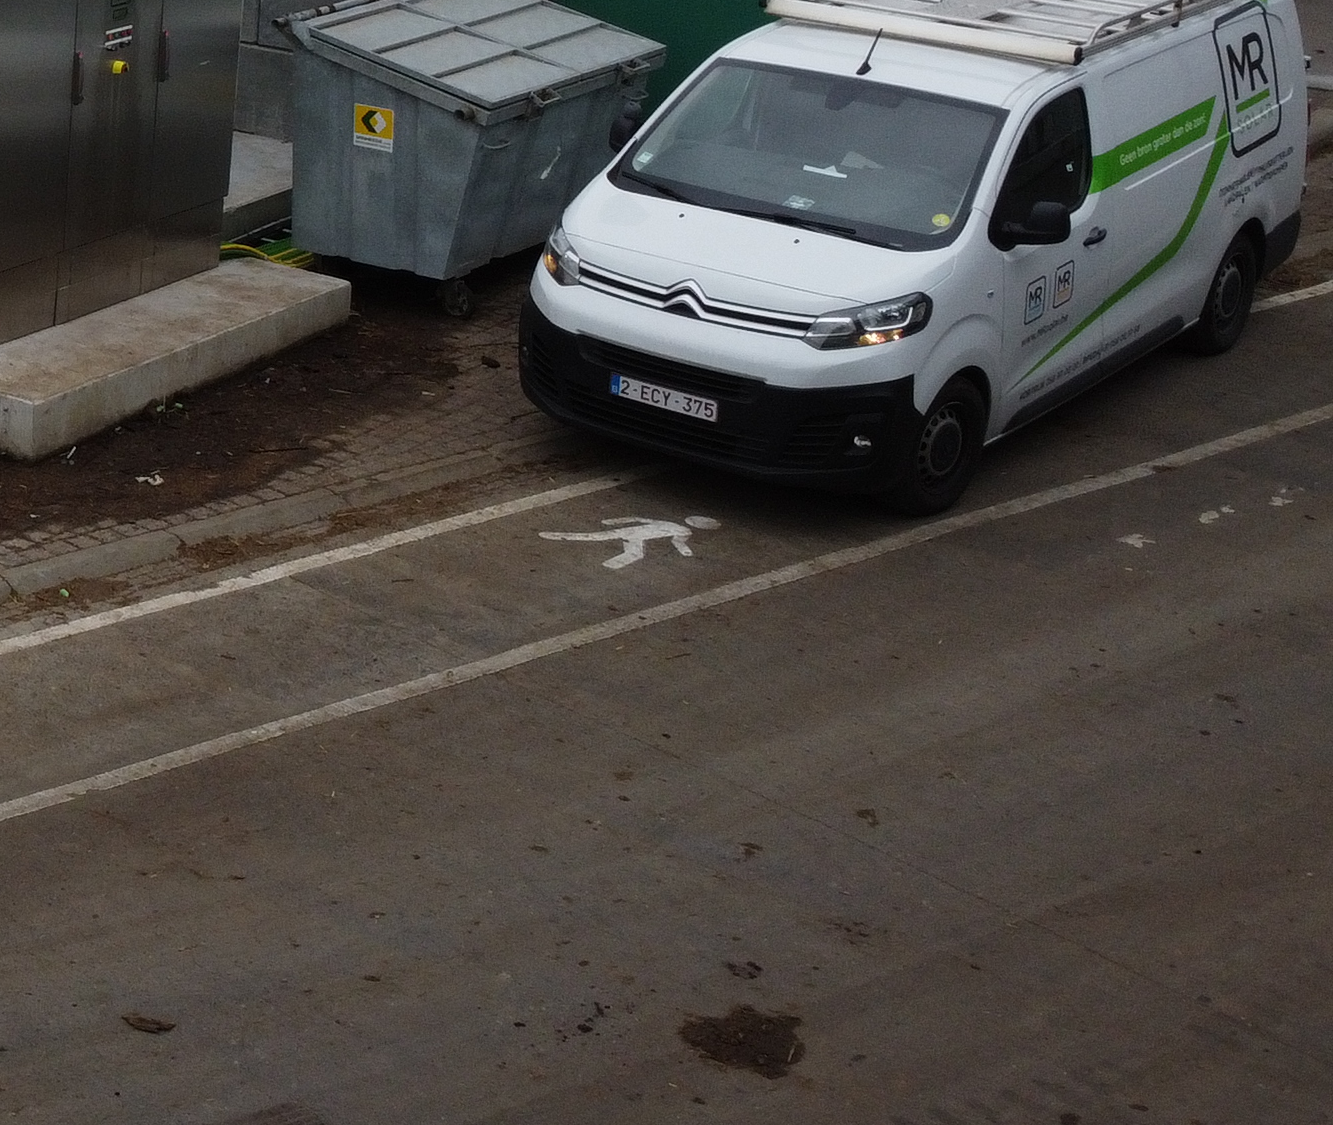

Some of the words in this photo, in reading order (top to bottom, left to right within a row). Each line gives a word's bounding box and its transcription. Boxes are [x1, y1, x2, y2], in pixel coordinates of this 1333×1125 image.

[1226, 32, 1268, 100] MR
[1119, 151, 1137, 166] Geen
[1137, 143, 1153, 157] bron
[1185, 121, 1193, 133] de
[1029, 286, 1043, 309] MR
[1057, 270, 1071, 292] MR
[620, 380, 715, 418] 2-ECY-375
